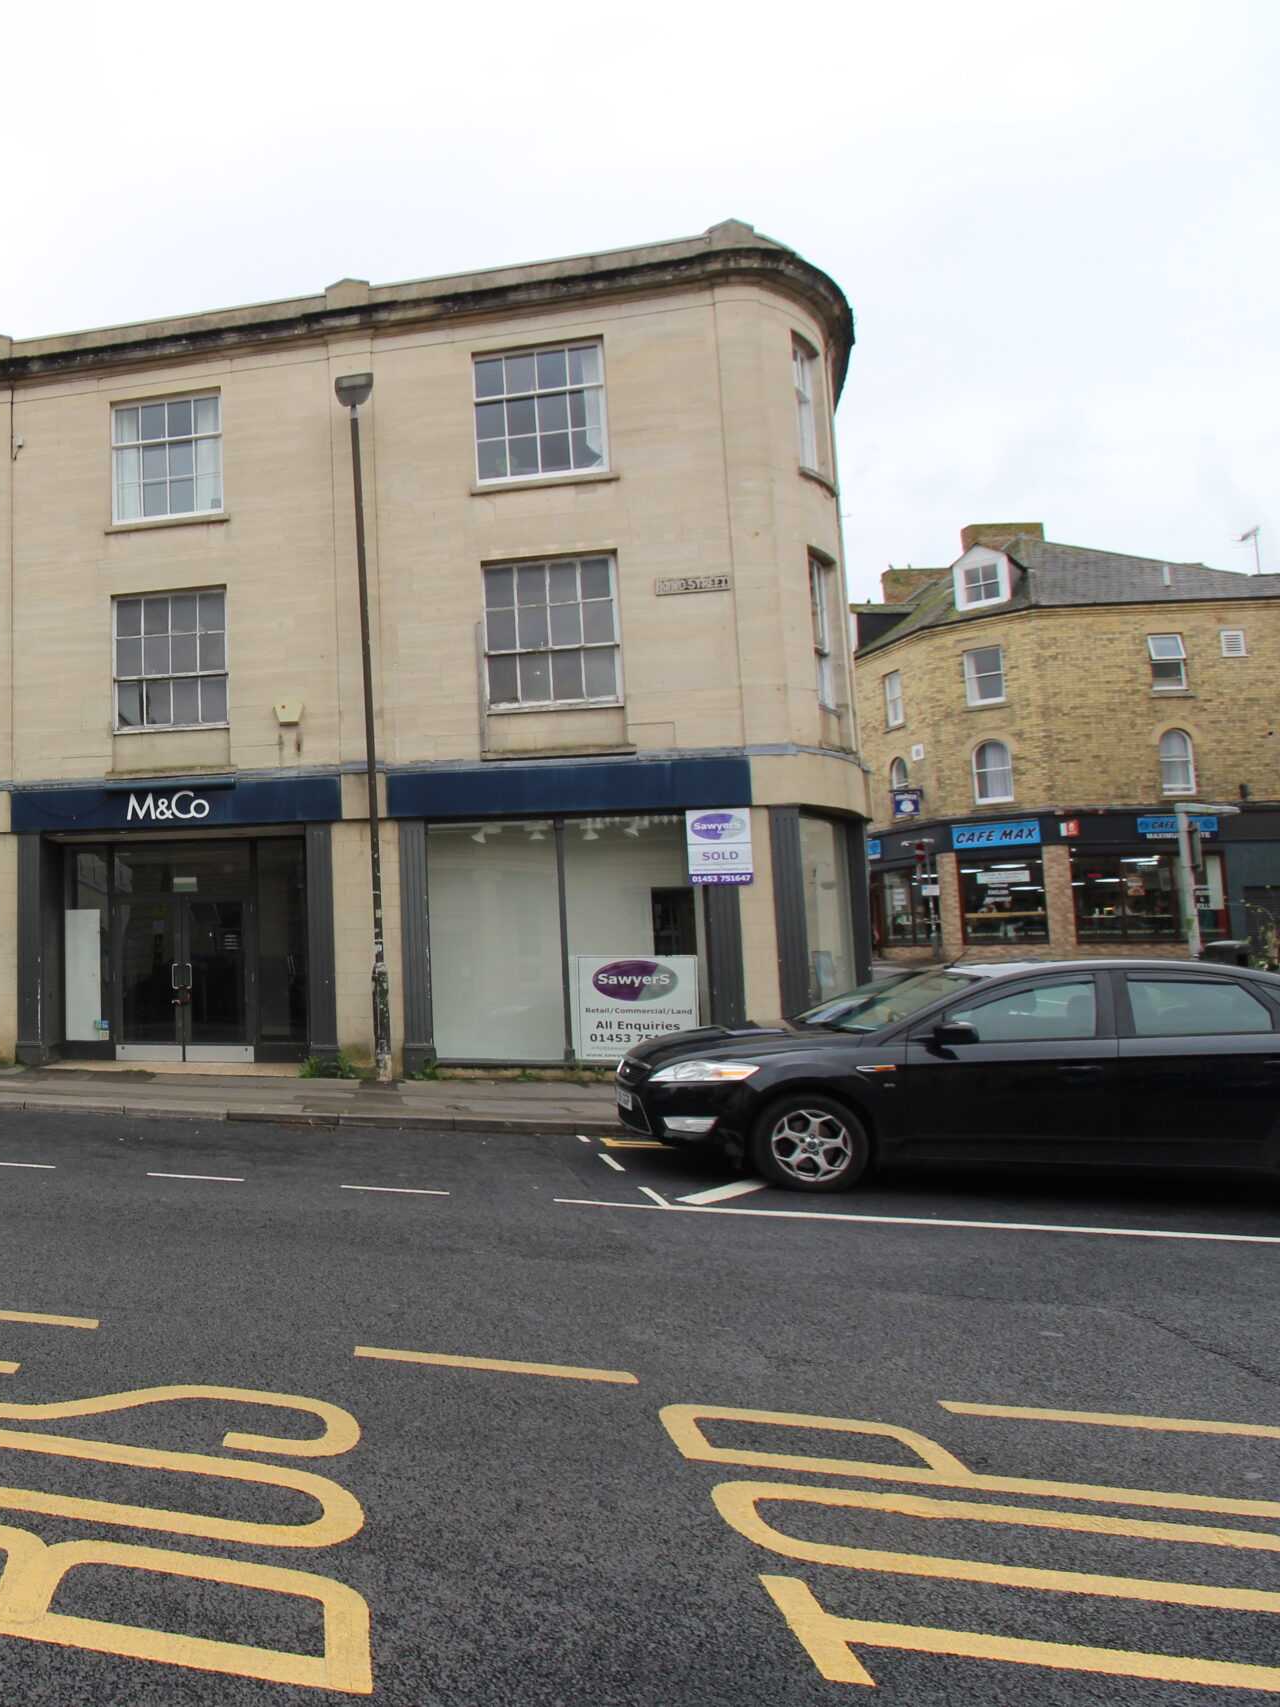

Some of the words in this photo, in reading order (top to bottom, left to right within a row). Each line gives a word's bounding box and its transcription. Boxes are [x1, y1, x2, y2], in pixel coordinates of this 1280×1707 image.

[126, 790, 210, 820] M&Co
[1151, 820, 1176, 829] CAFE
[956, 830, 995, 844] CAFE
[999, 827, 1037, 841] MAX
[702, 851, 739, 861] SOLD
[720, 874, 751, 882] 751647
[596, 1020, 613, 1030] All
[617, 1020, 681, 1032] Enquiries
[590, 1033, 632, 1043] 01453
[659, 1403, 1280, 1693] TOP
